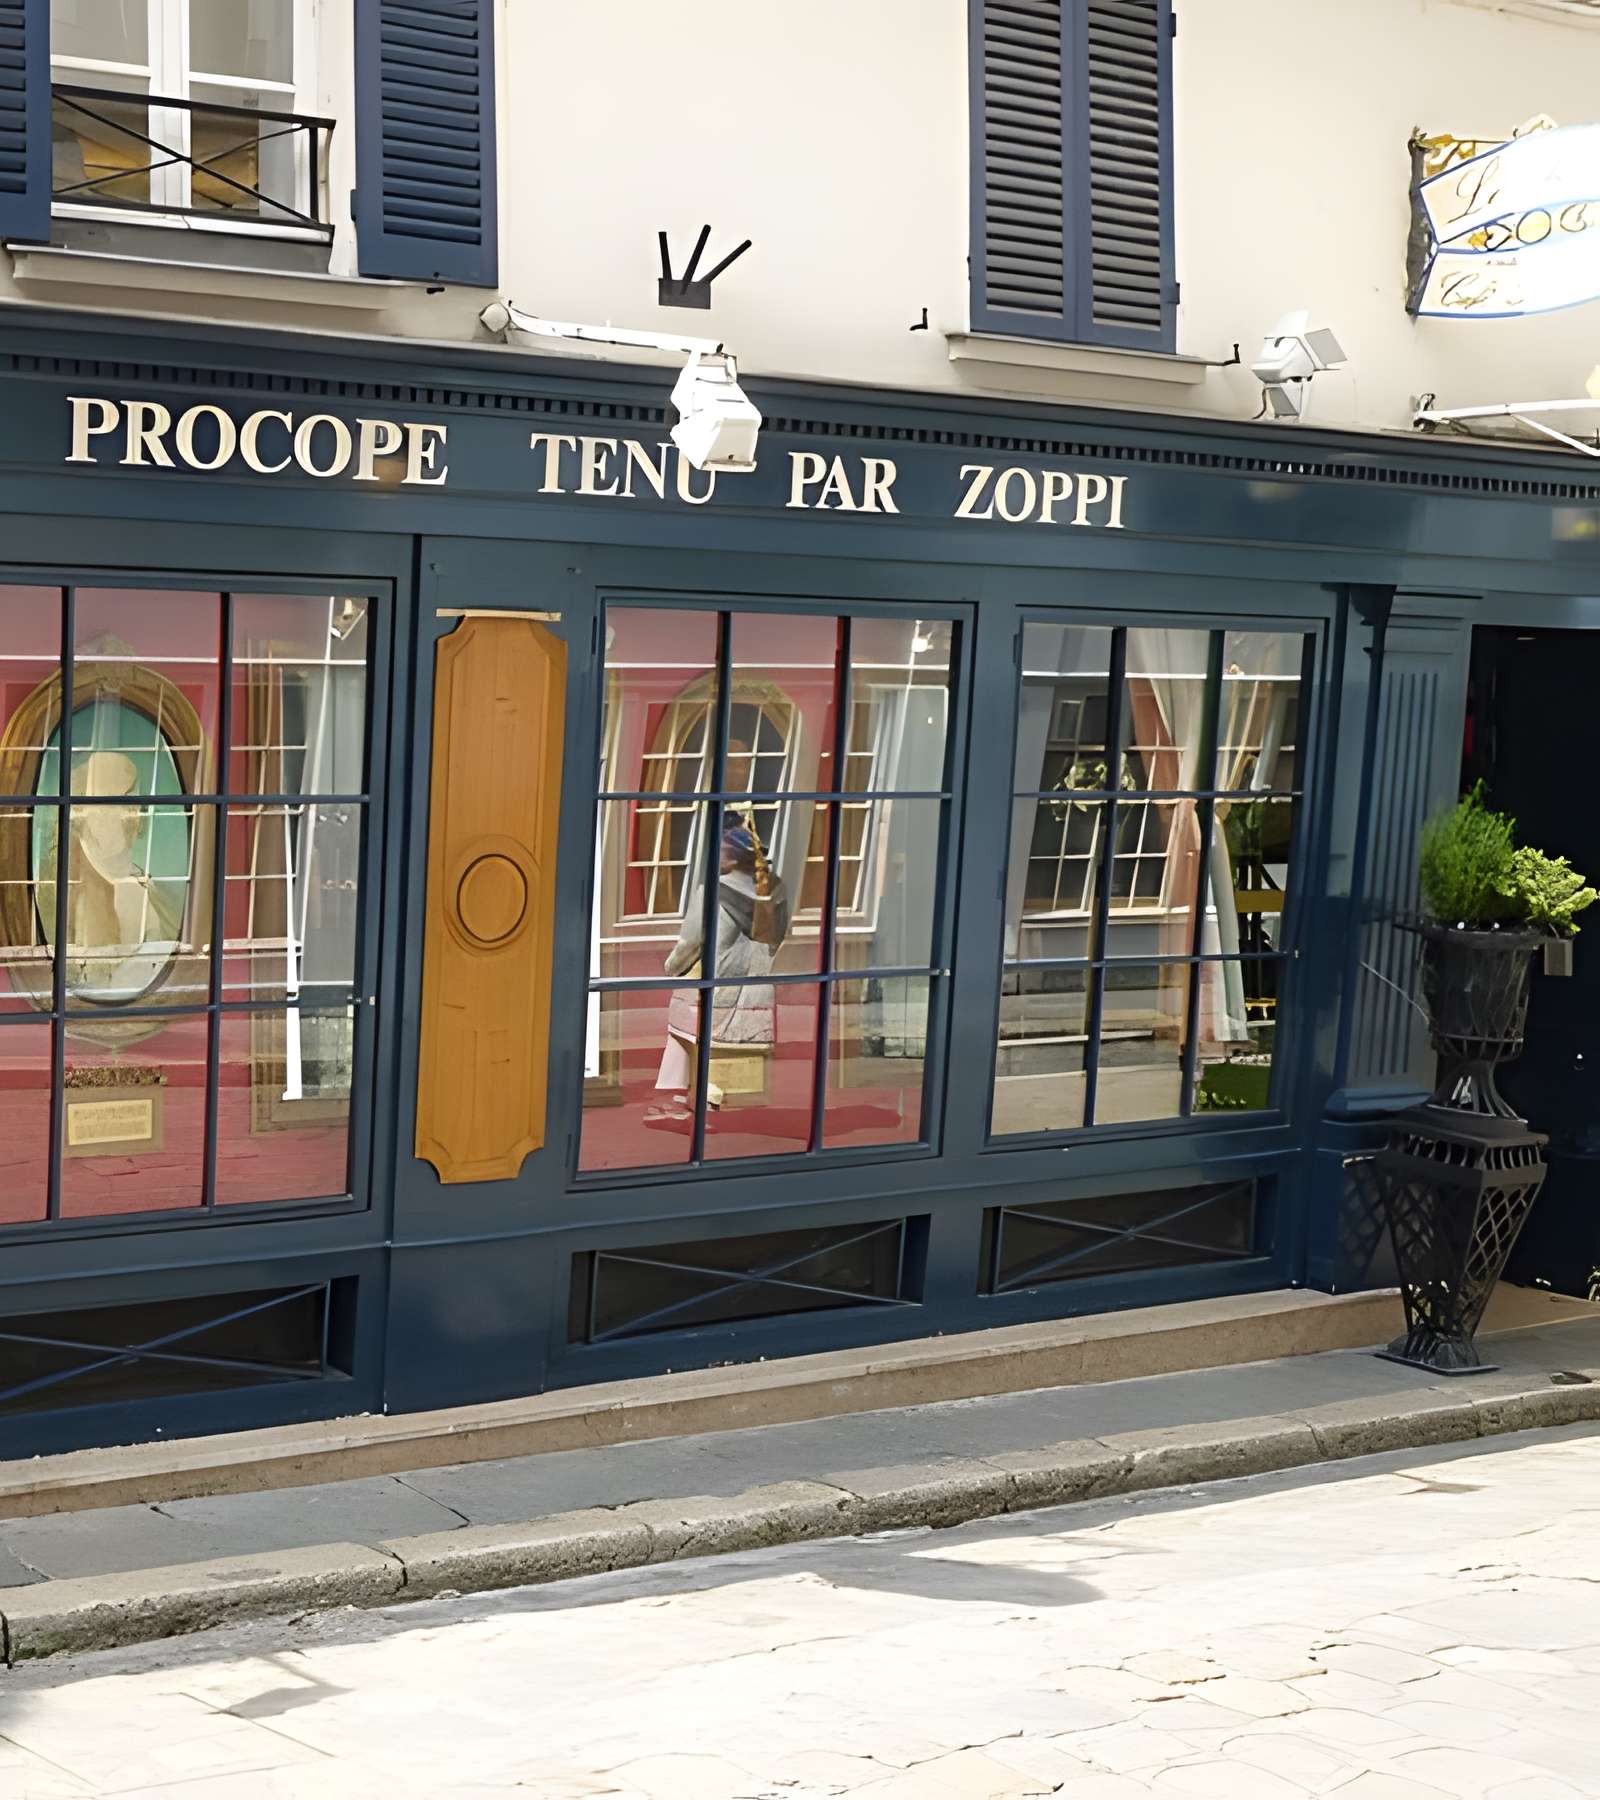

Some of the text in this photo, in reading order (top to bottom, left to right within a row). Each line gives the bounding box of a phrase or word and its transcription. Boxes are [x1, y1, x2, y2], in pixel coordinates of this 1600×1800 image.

[64, 396, 449, 487] PROCOPE
[530, 432, 717, 505] TENU
[785, 451, 901, 514] PAR
[953, 464, 1129, 529] ZOPPI
